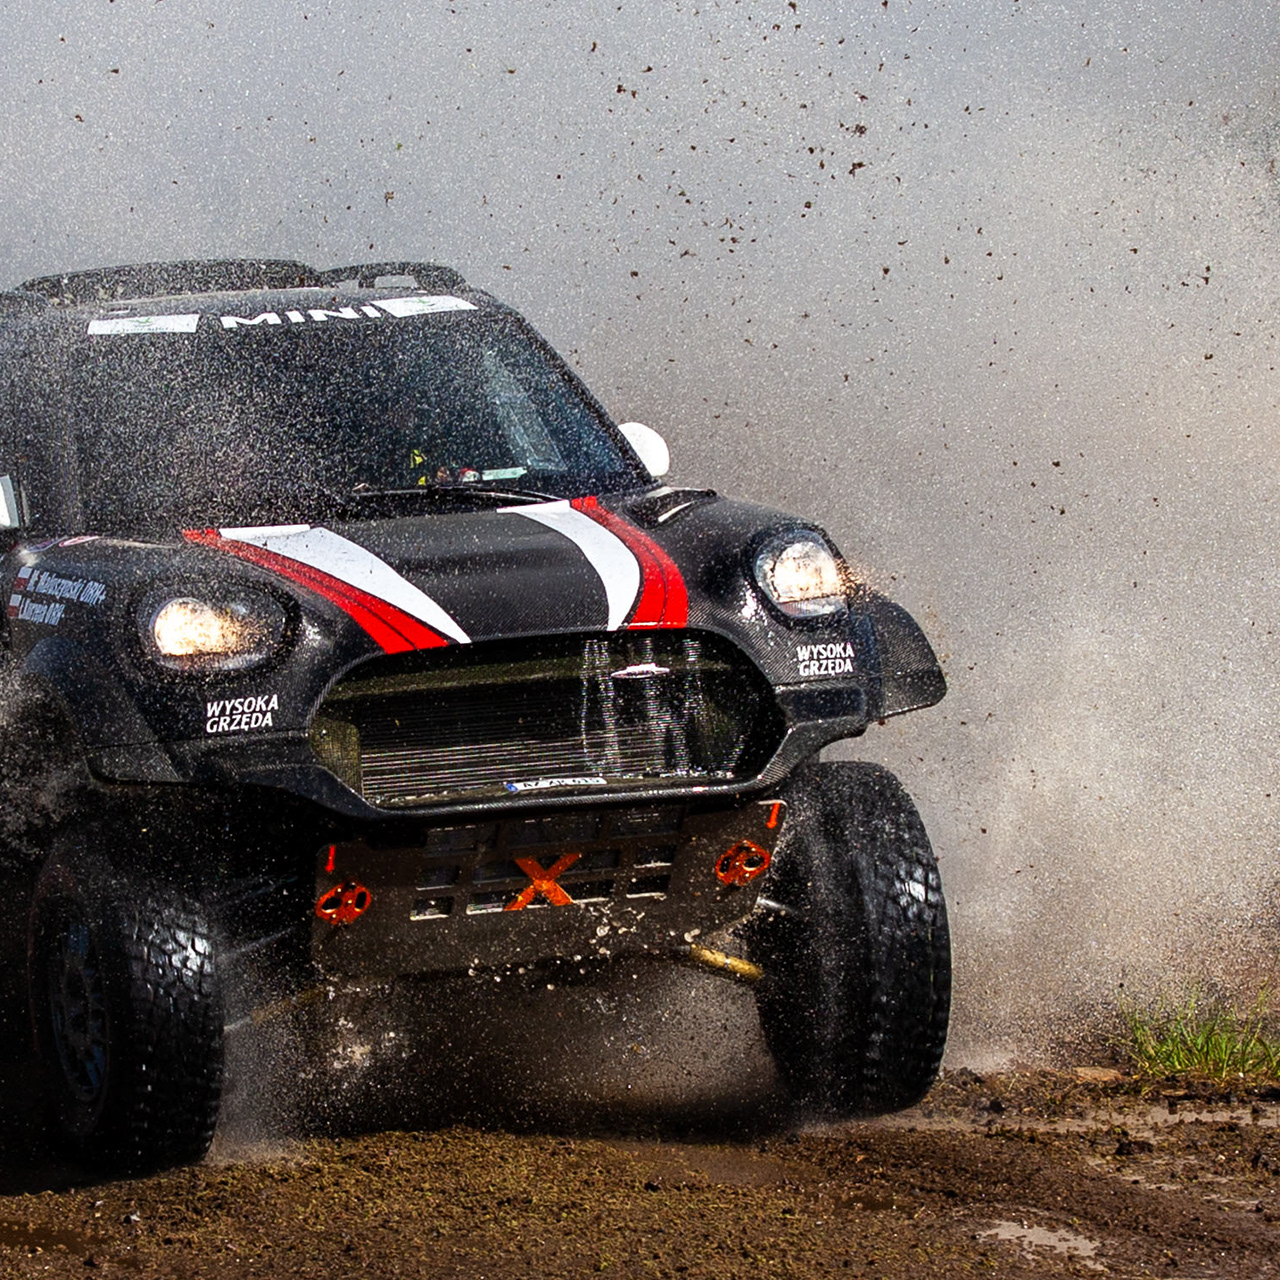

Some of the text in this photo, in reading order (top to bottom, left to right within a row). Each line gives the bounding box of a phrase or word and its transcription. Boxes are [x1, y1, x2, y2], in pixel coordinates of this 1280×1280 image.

[220, 305, 382, 328] MINI
[796, 642, 854, 661] WYSOKA
[800, 659, 853, 676] GRZĘDA
[207, 694, 278, 717] WYSOKA
[206, 712, 272, 732] GRZĘDA
